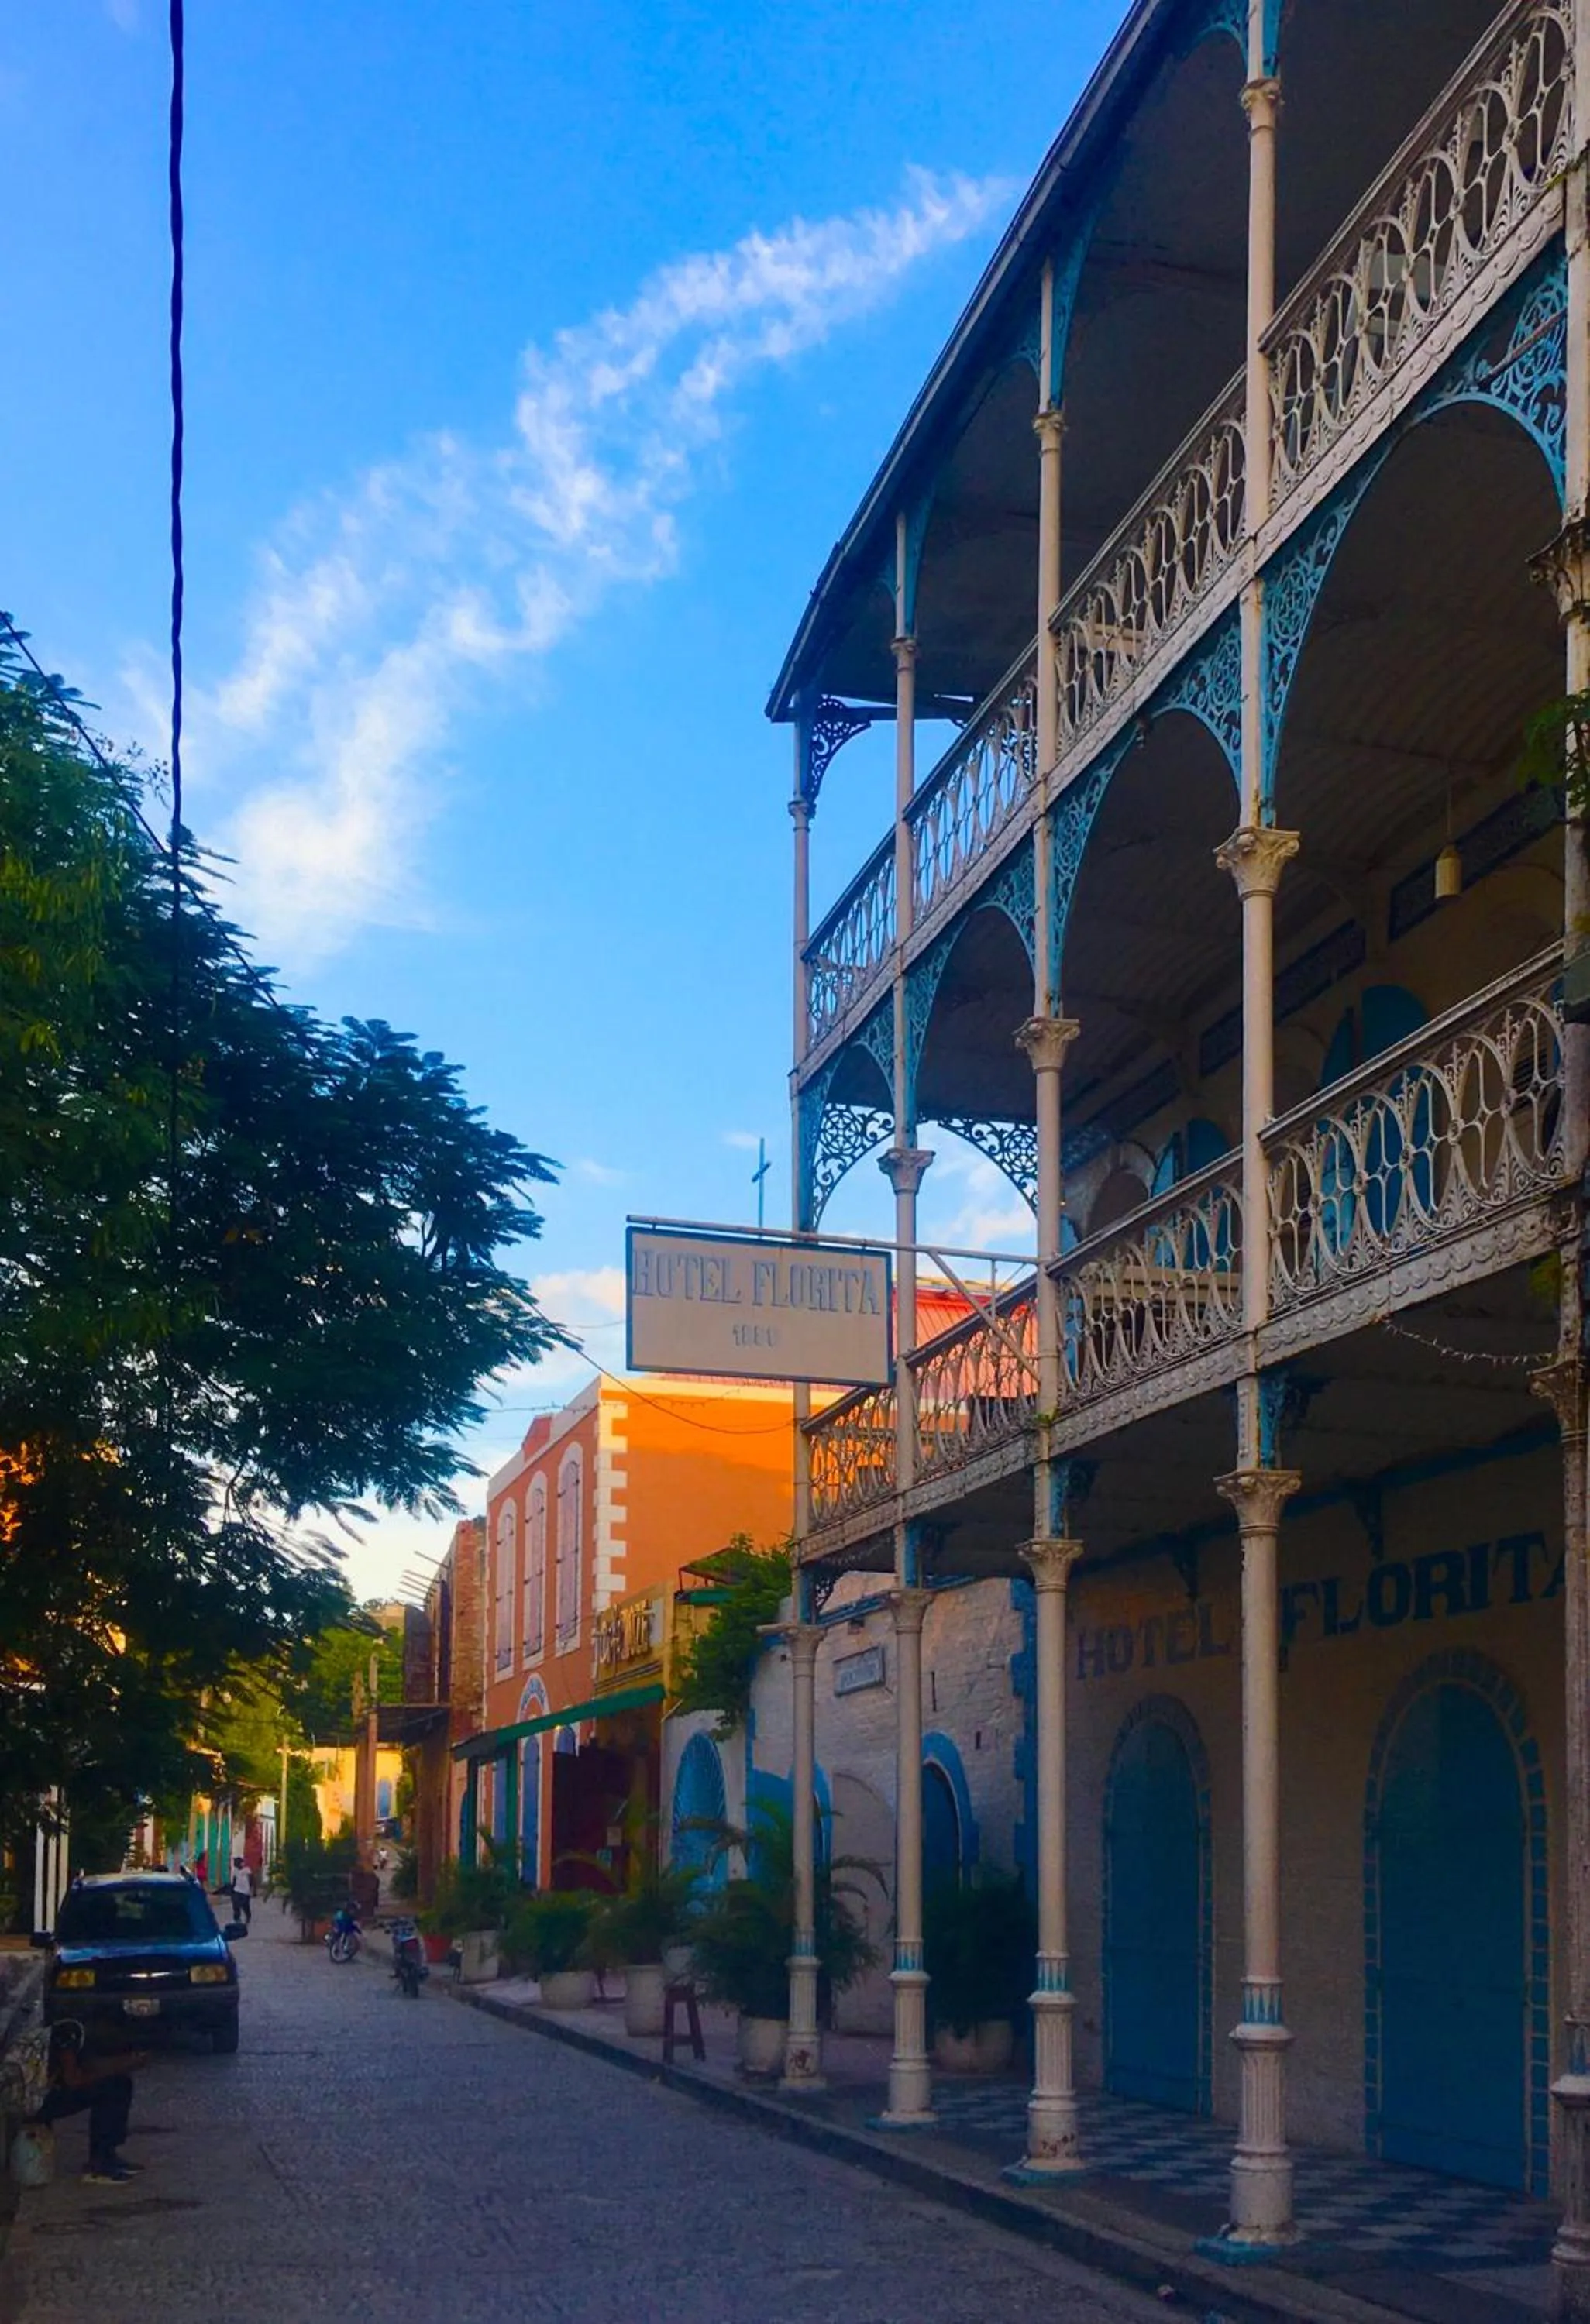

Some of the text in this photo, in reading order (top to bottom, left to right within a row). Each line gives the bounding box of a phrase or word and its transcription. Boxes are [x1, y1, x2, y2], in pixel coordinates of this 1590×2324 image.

[632, 1248, 882, 1315] HOTEL FLORITA
[1075, 1602, 1230, 1681] HOTEL
